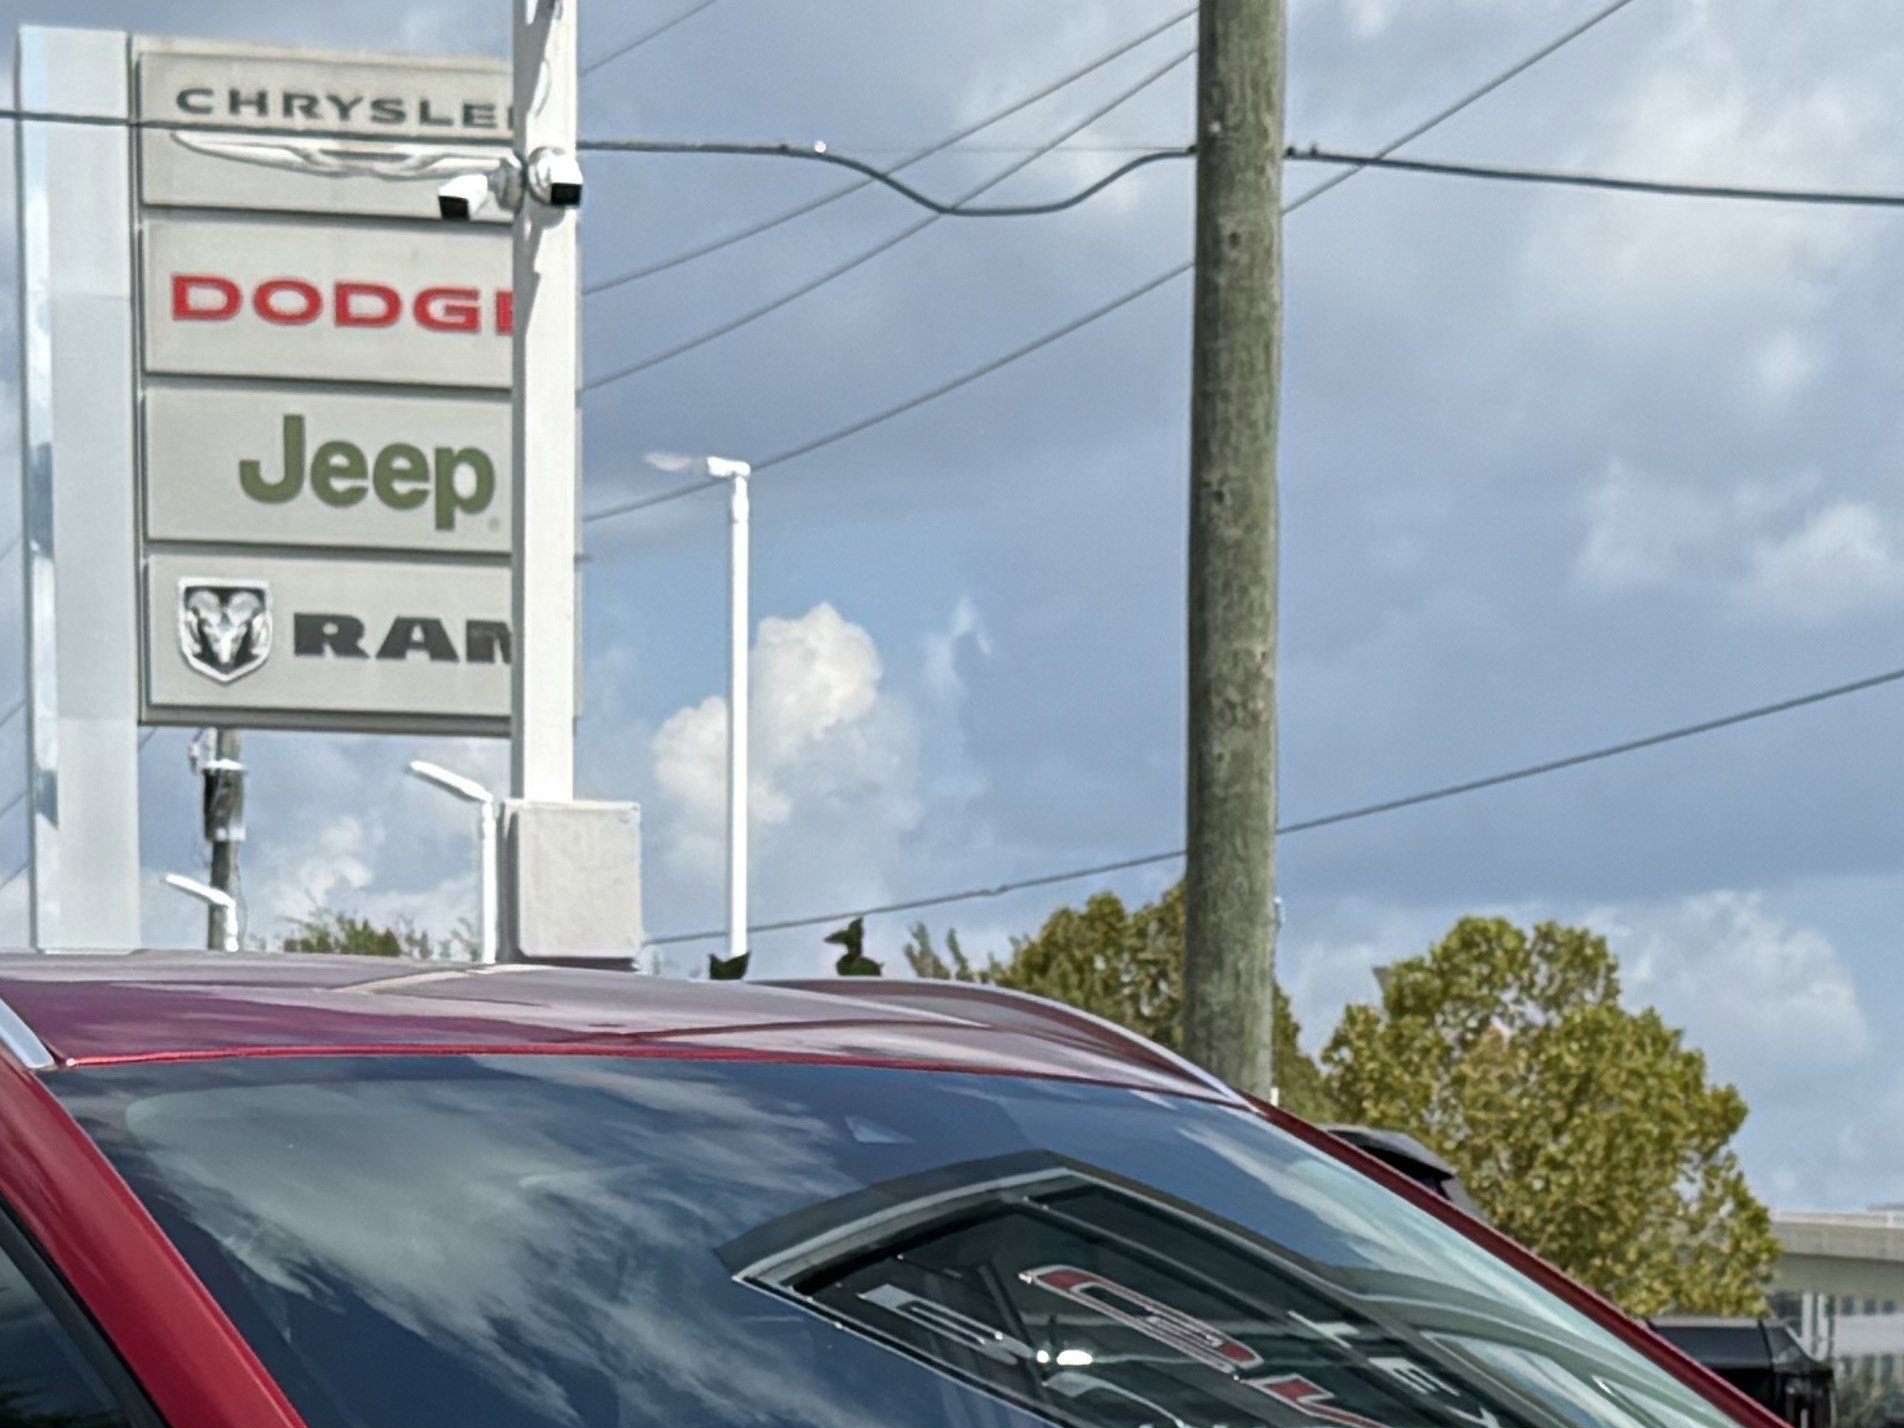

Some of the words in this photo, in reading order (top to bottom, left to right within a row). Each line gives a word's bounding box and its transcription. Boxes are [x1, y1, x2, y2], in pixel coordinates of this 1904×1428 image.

[175, 86, 513, 129] CHRYSLE
[171, 273, 513, 336] DODG
[238, 413, 496, 531] Jeep
